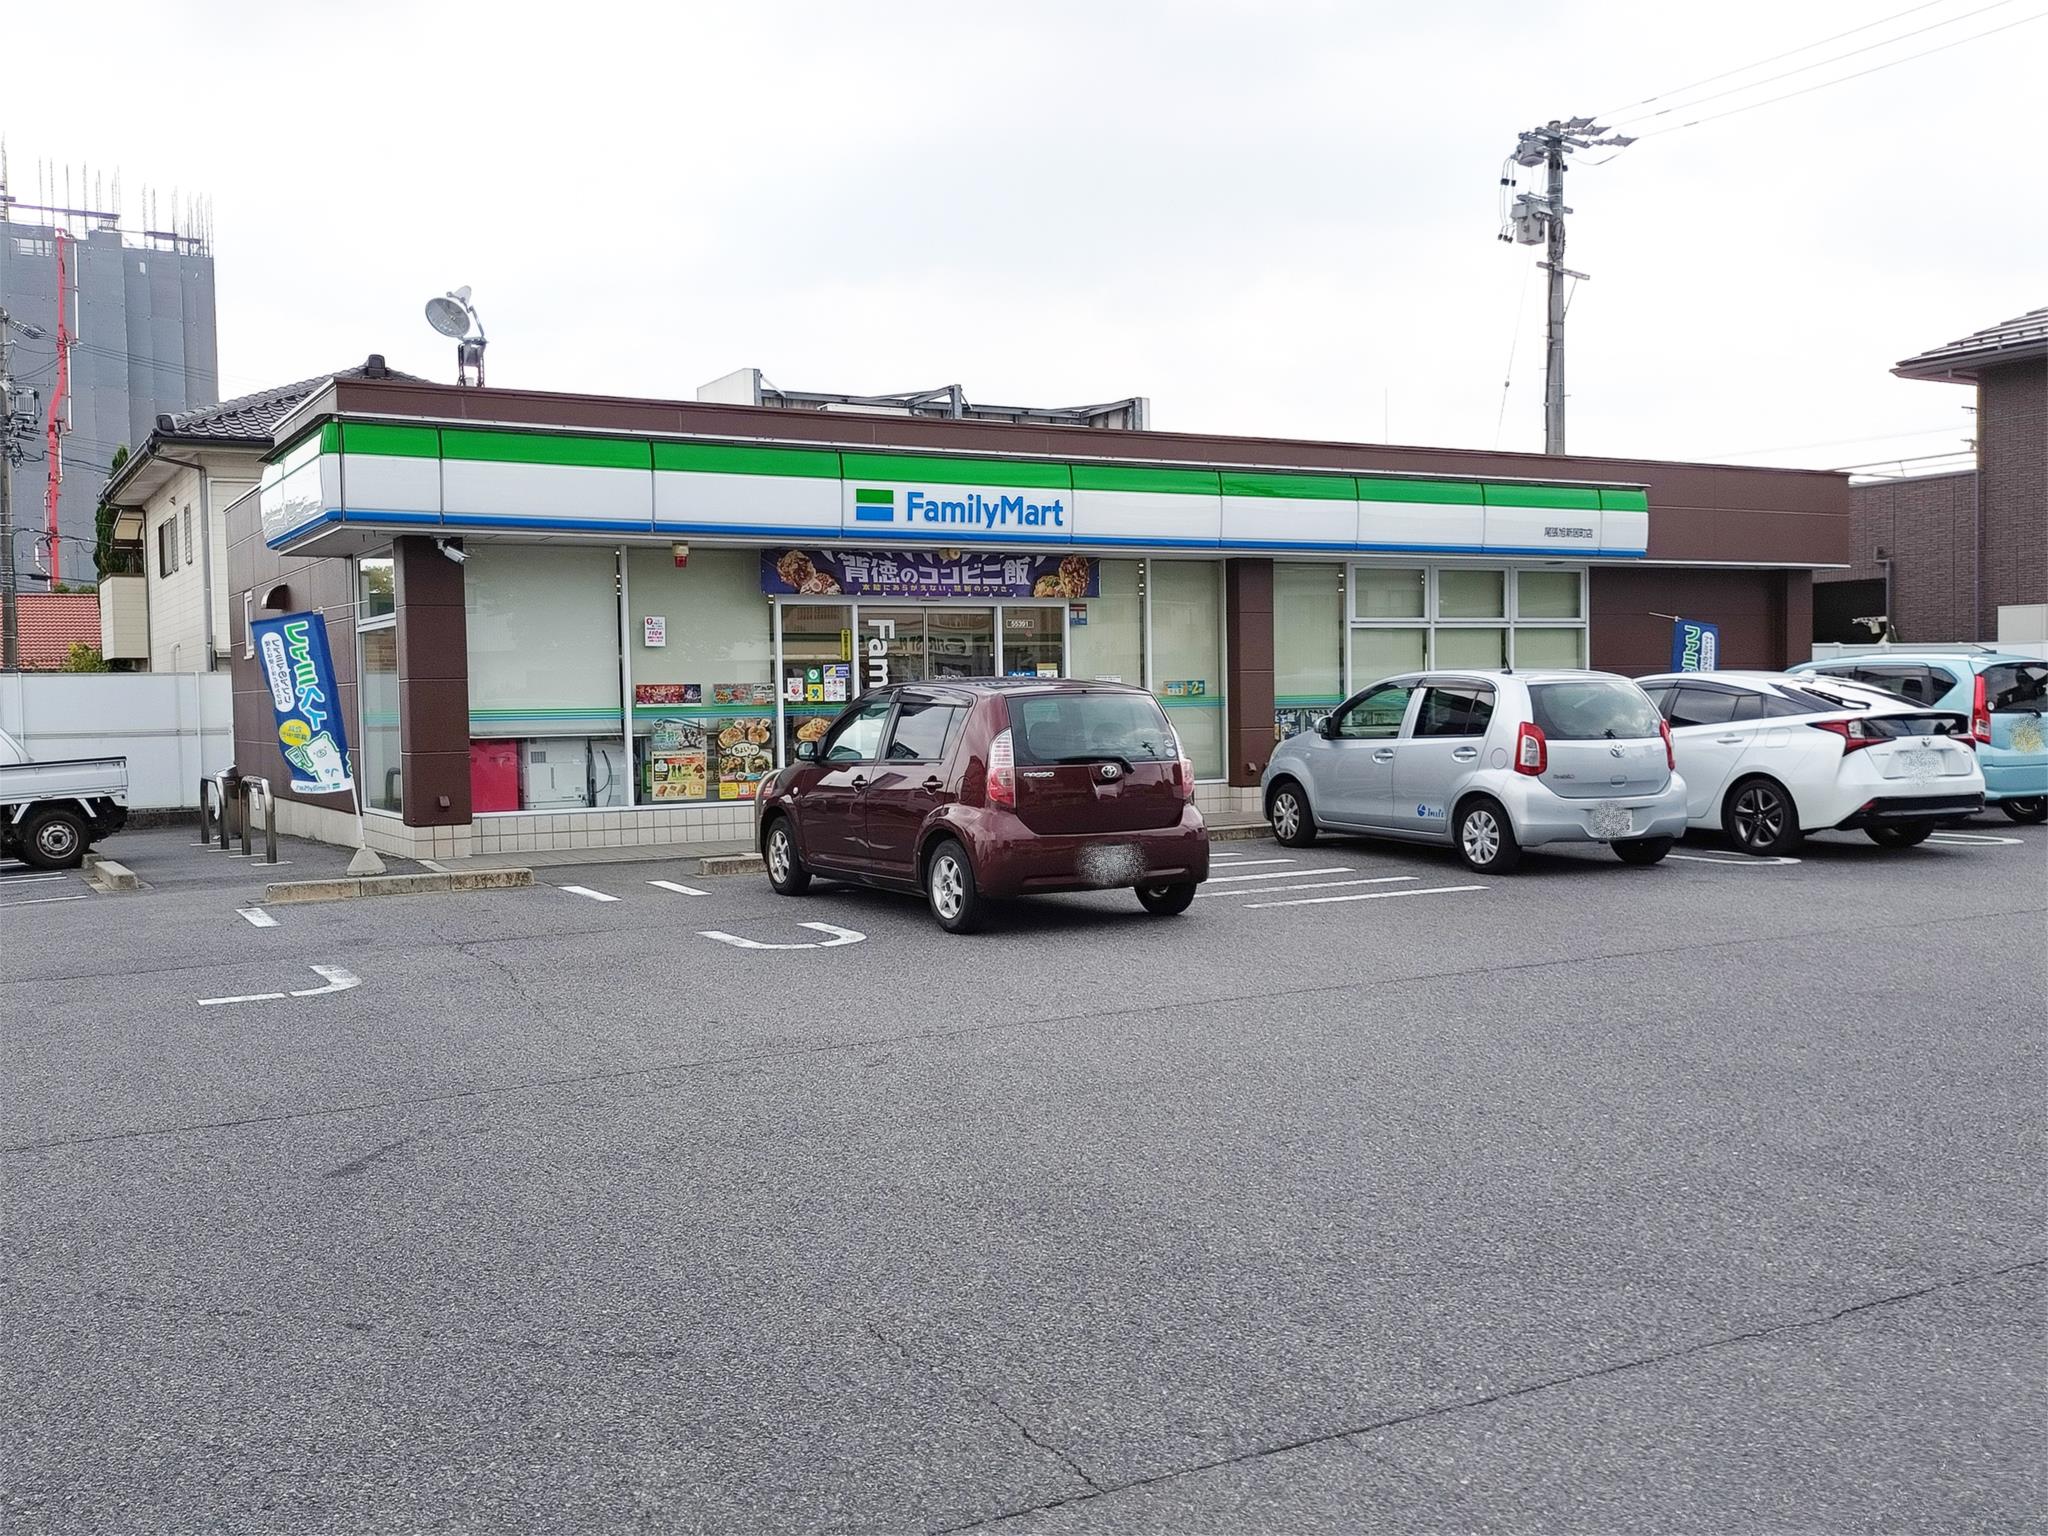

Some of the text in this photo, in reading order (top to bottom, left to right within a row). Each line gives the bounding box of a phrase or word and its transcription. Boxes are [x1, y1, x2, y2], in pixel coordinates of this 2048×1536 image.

[907, 491, 1064, 529] FamilyMart
[839, 552, 1031, 586] 背徳のコンビニ飯
